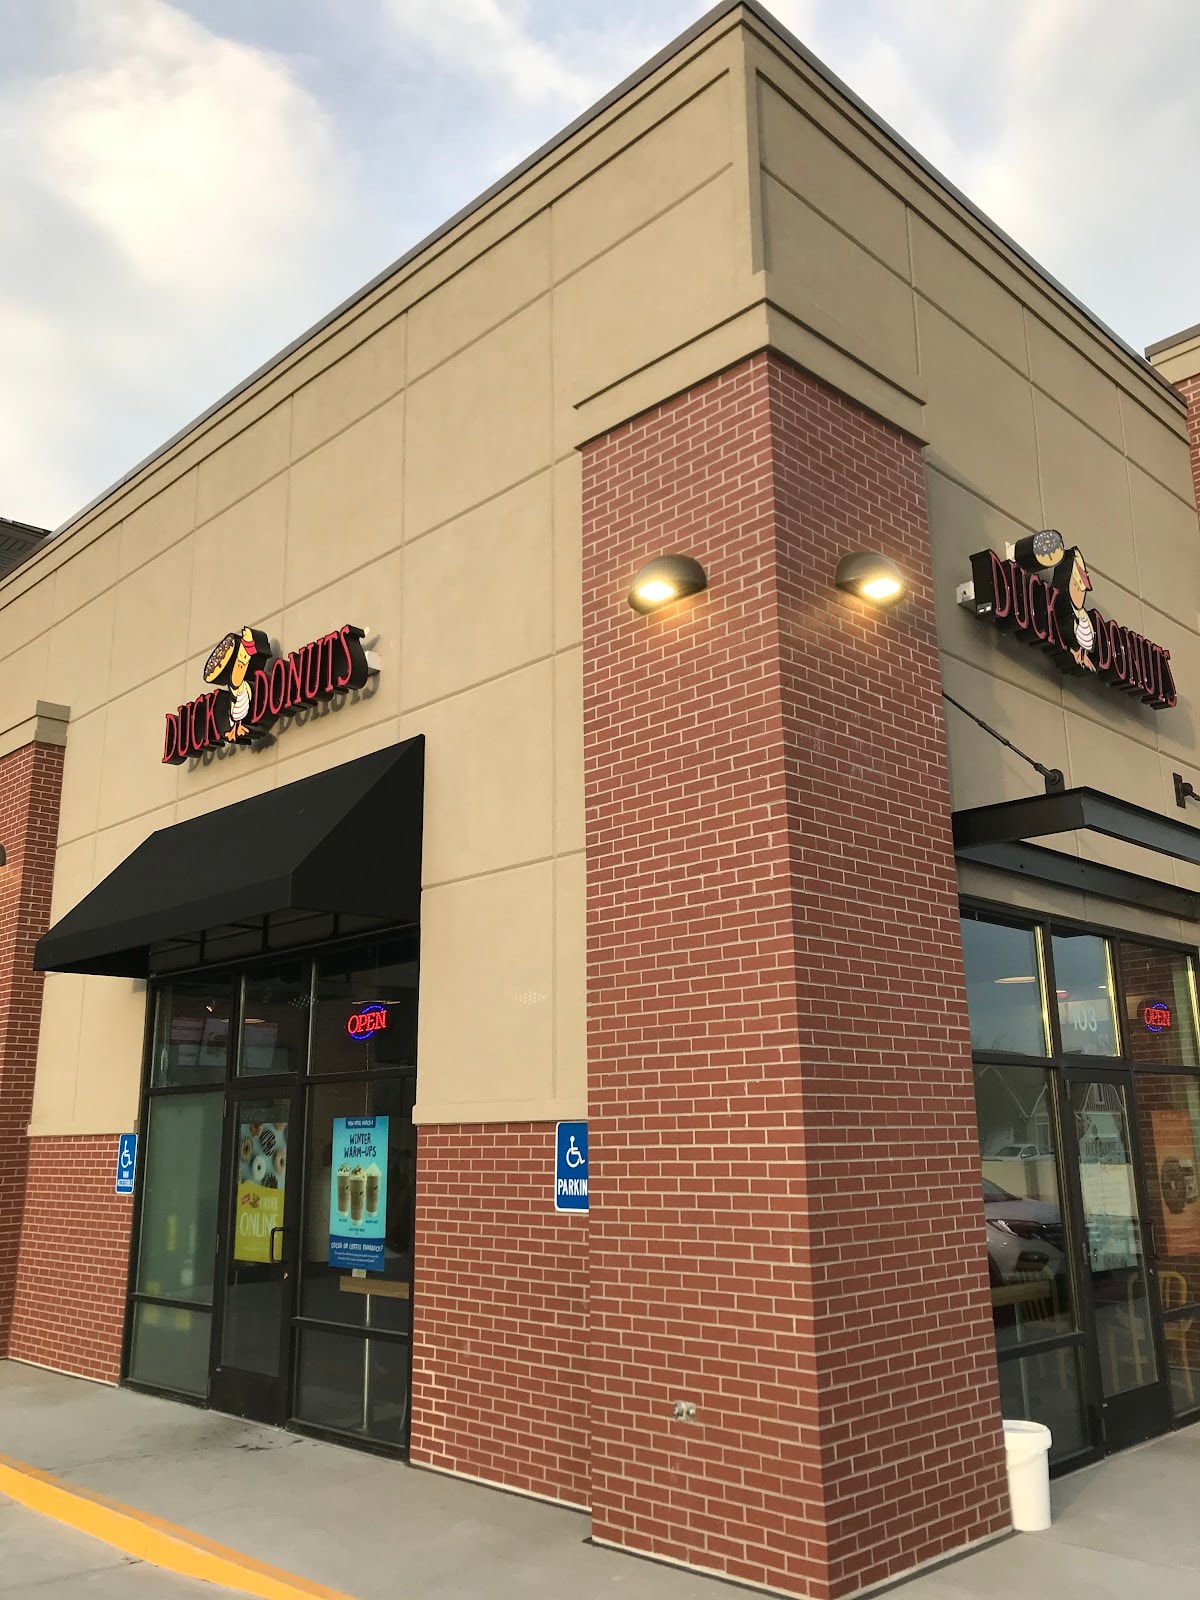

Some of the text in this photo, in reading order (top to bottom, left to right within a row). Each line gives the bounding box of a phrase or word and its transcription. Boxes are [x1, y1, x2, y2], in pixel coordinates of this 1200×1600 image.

[990, 549, 1178, 707] DUCK DONUTS
[161, 624, 351, 764] DUCK DONUTS
[347, 1010, 388, 1035] OPEN
[1143, 1007, 1171, 1027] OPEN
[349, 1132, 371, 1146] WINTER
[343, 1145, 377, 1159] WARM-UPS
[558, 1178, 588, 1197] PARKIN
[240, 1211, 279, 1238] ONLINE
